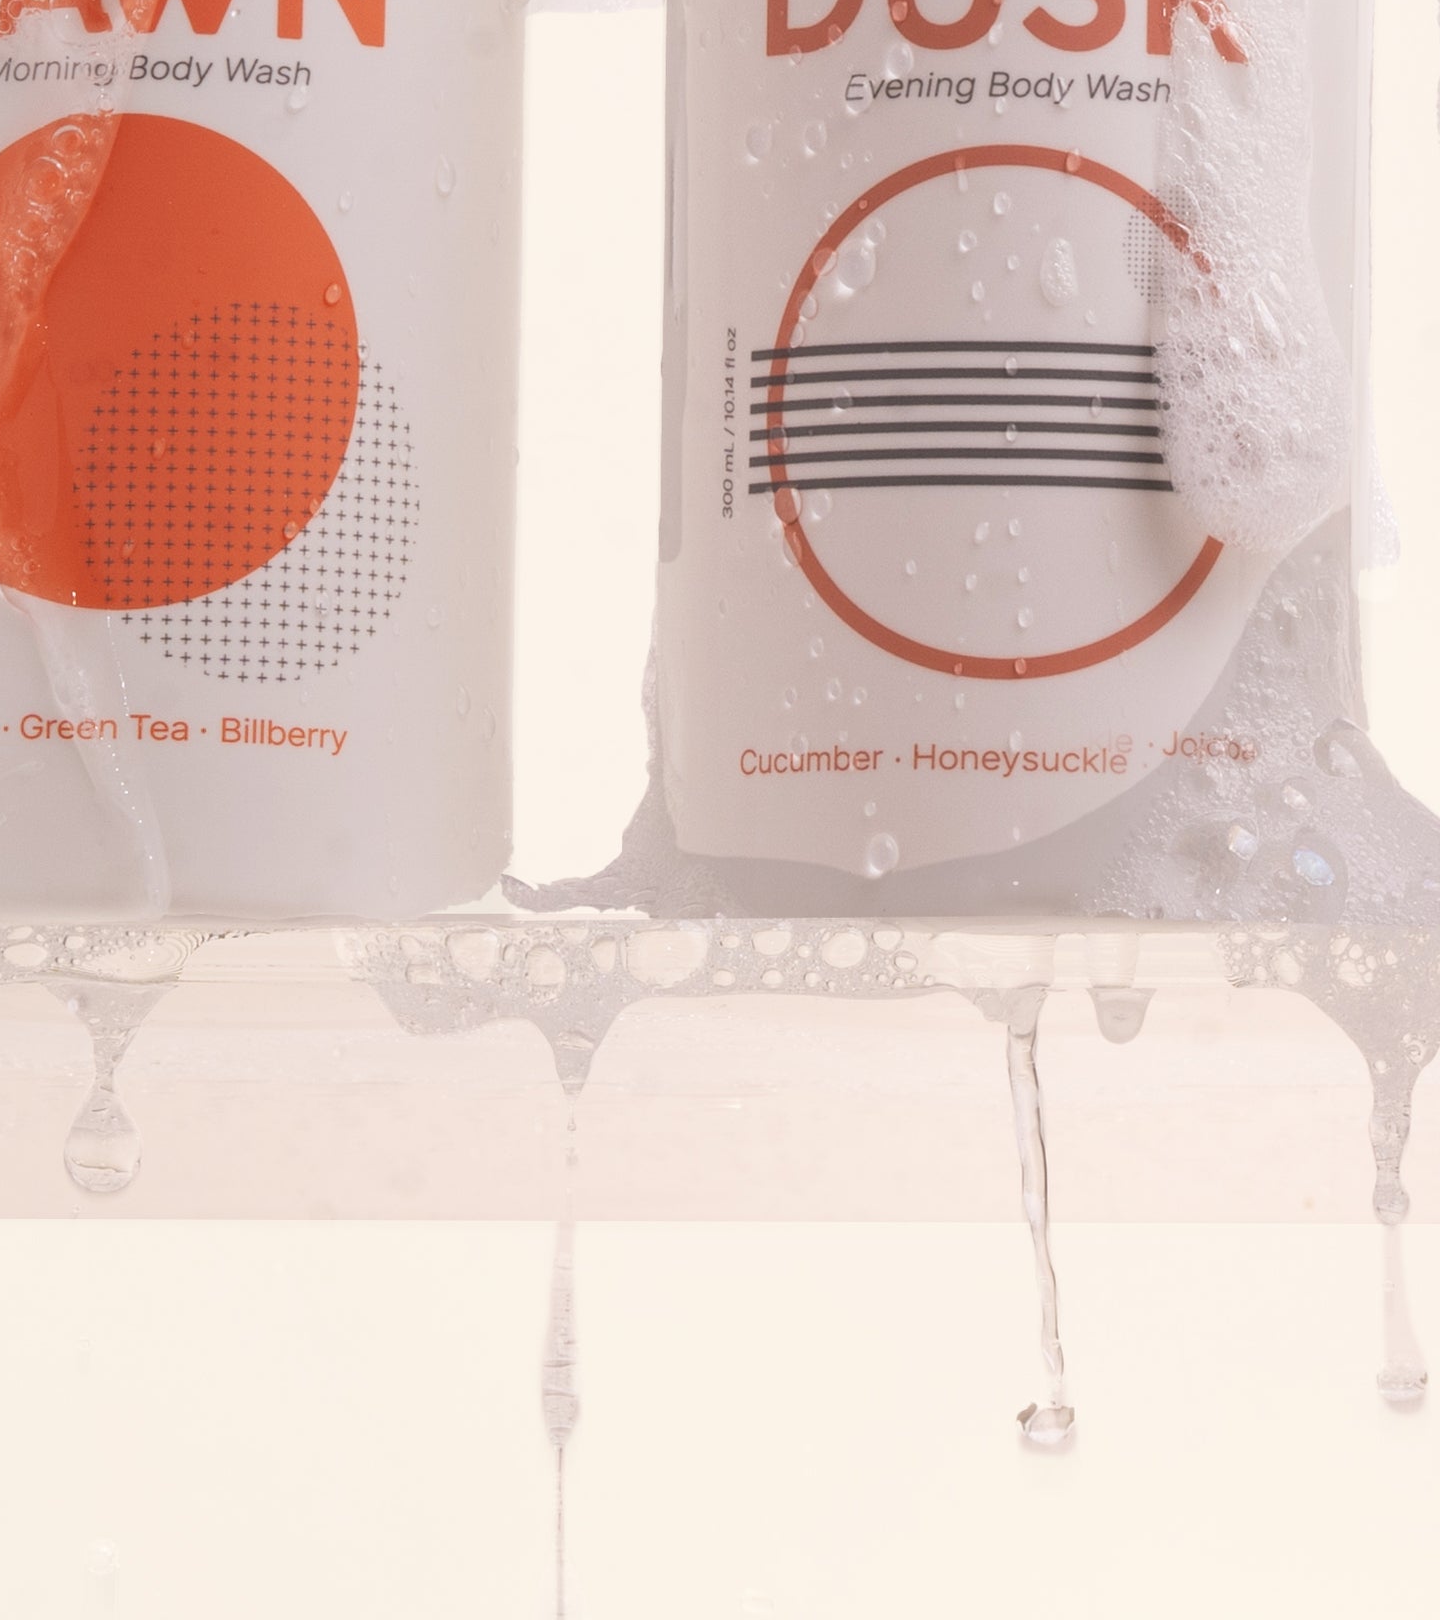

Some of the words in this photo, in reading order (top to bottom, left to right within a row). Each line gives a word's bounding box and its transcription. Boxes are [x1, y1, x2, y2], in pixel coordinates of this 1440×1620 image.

[129, 55, 213, 87] Body
[226, 56, 311, 86] Wash
[845, 72, 976, 104] Evening
[988, 71, 1073, 103] Body
[1086, 72, 1172, 104] Wash
[727, 327, 736, 352] oz
[722, 478, 733, 519] 300
[20, 713, 118, 743] Green
[130, 714, 189, 743] Tea
[220, 718, 348, 755] Billberry
[740, 745, 883, 775] Cucumber
[913, 742, 1128, 777] Honeysuckle
